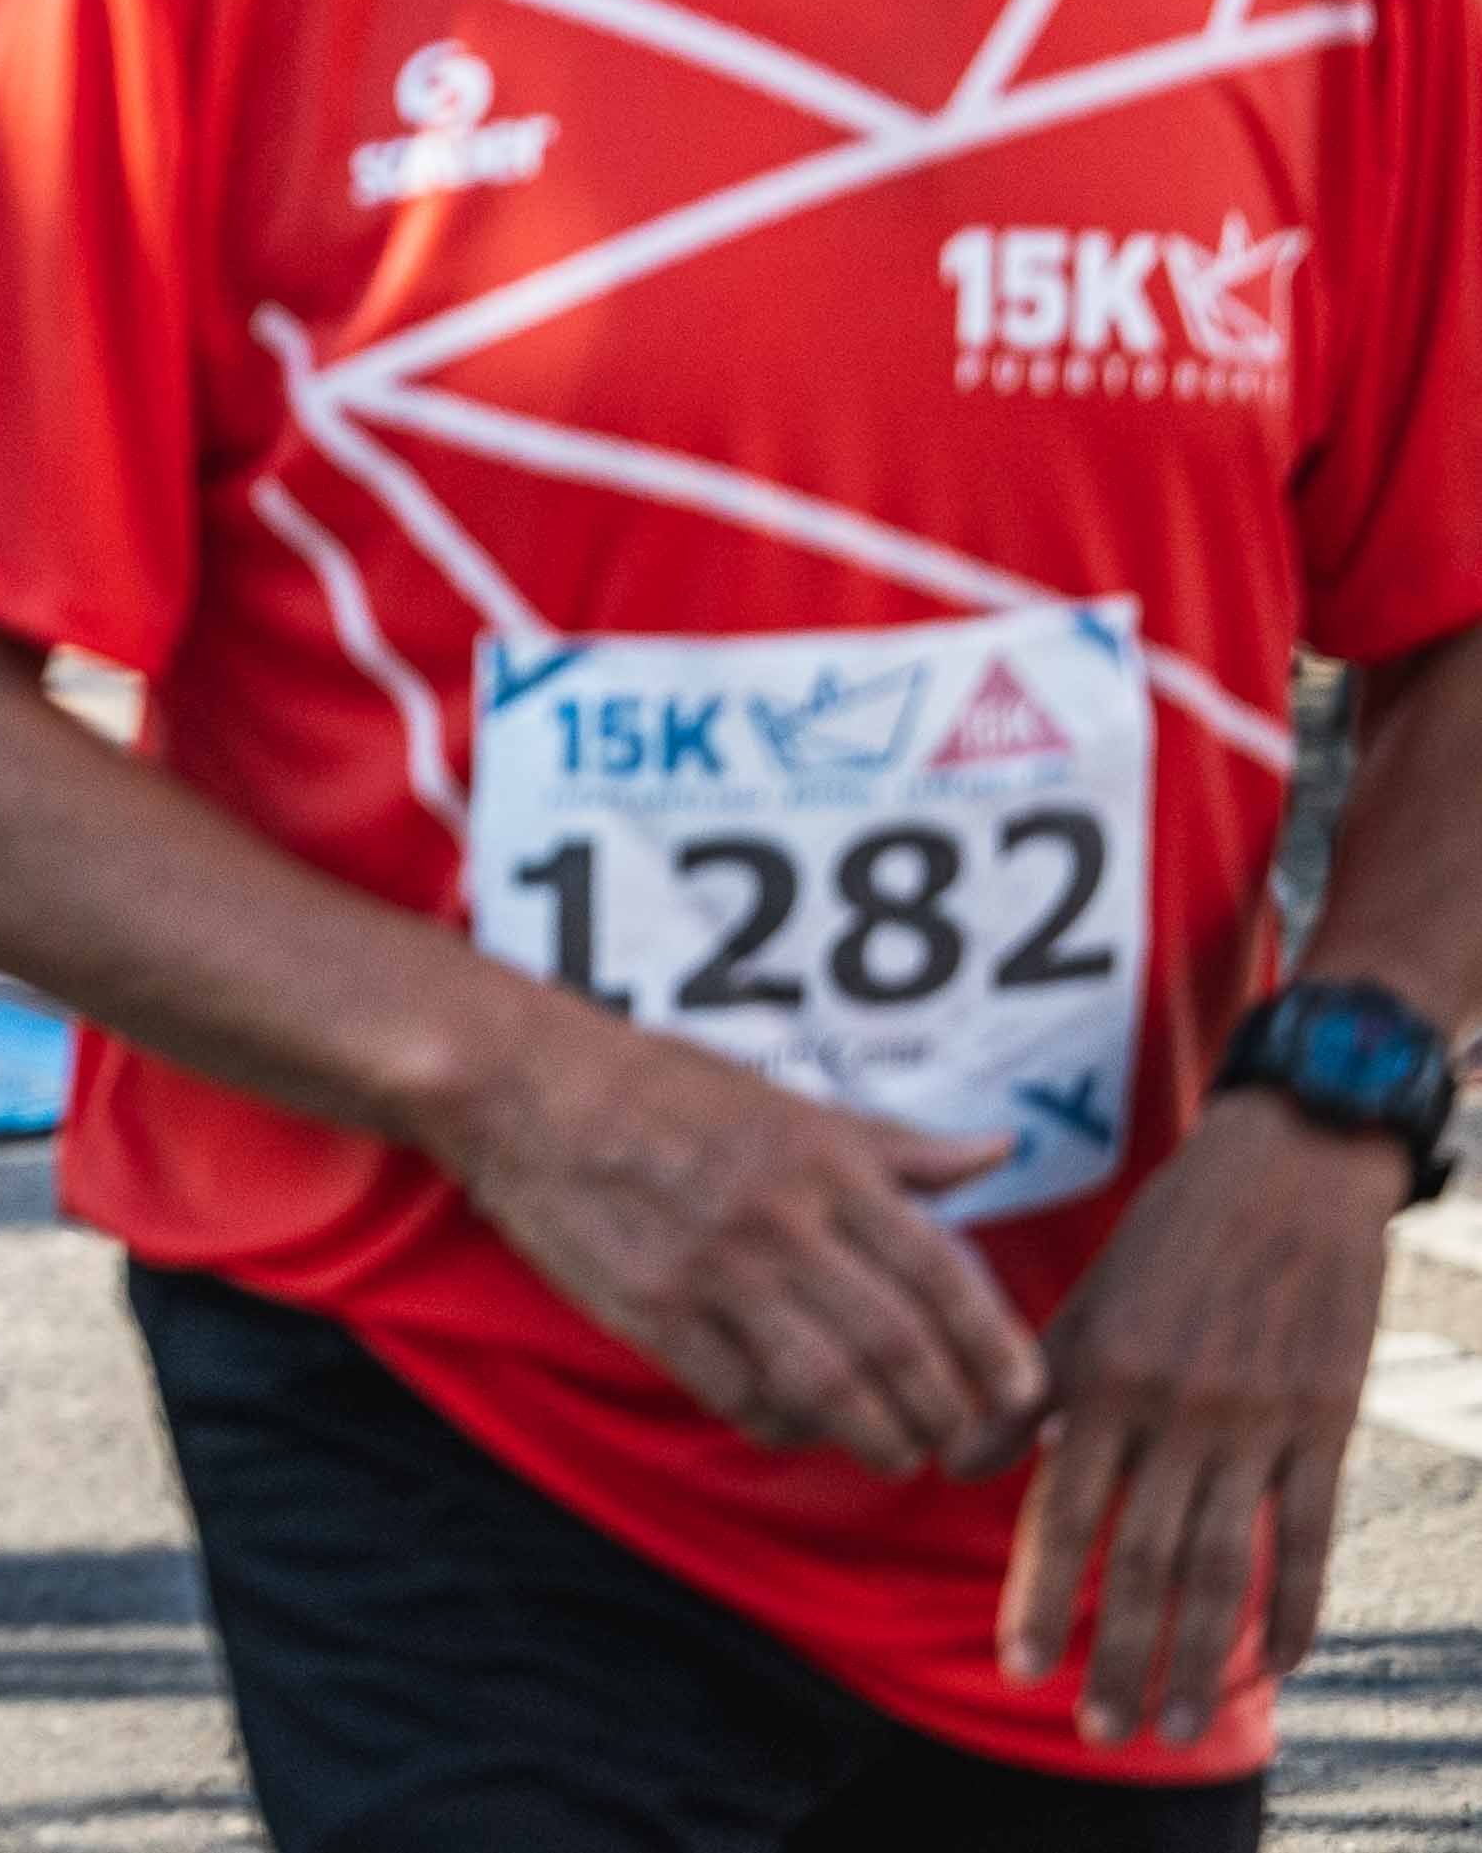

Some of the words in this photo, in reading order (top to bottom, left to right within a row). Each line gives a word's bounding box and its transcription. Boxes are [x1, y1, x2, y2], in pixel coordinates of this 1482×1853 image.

[939, 226, 1166, 350] 15K
[557, 694, 724, 776] 15K
[513, 810, 1115, 1014] 1282
